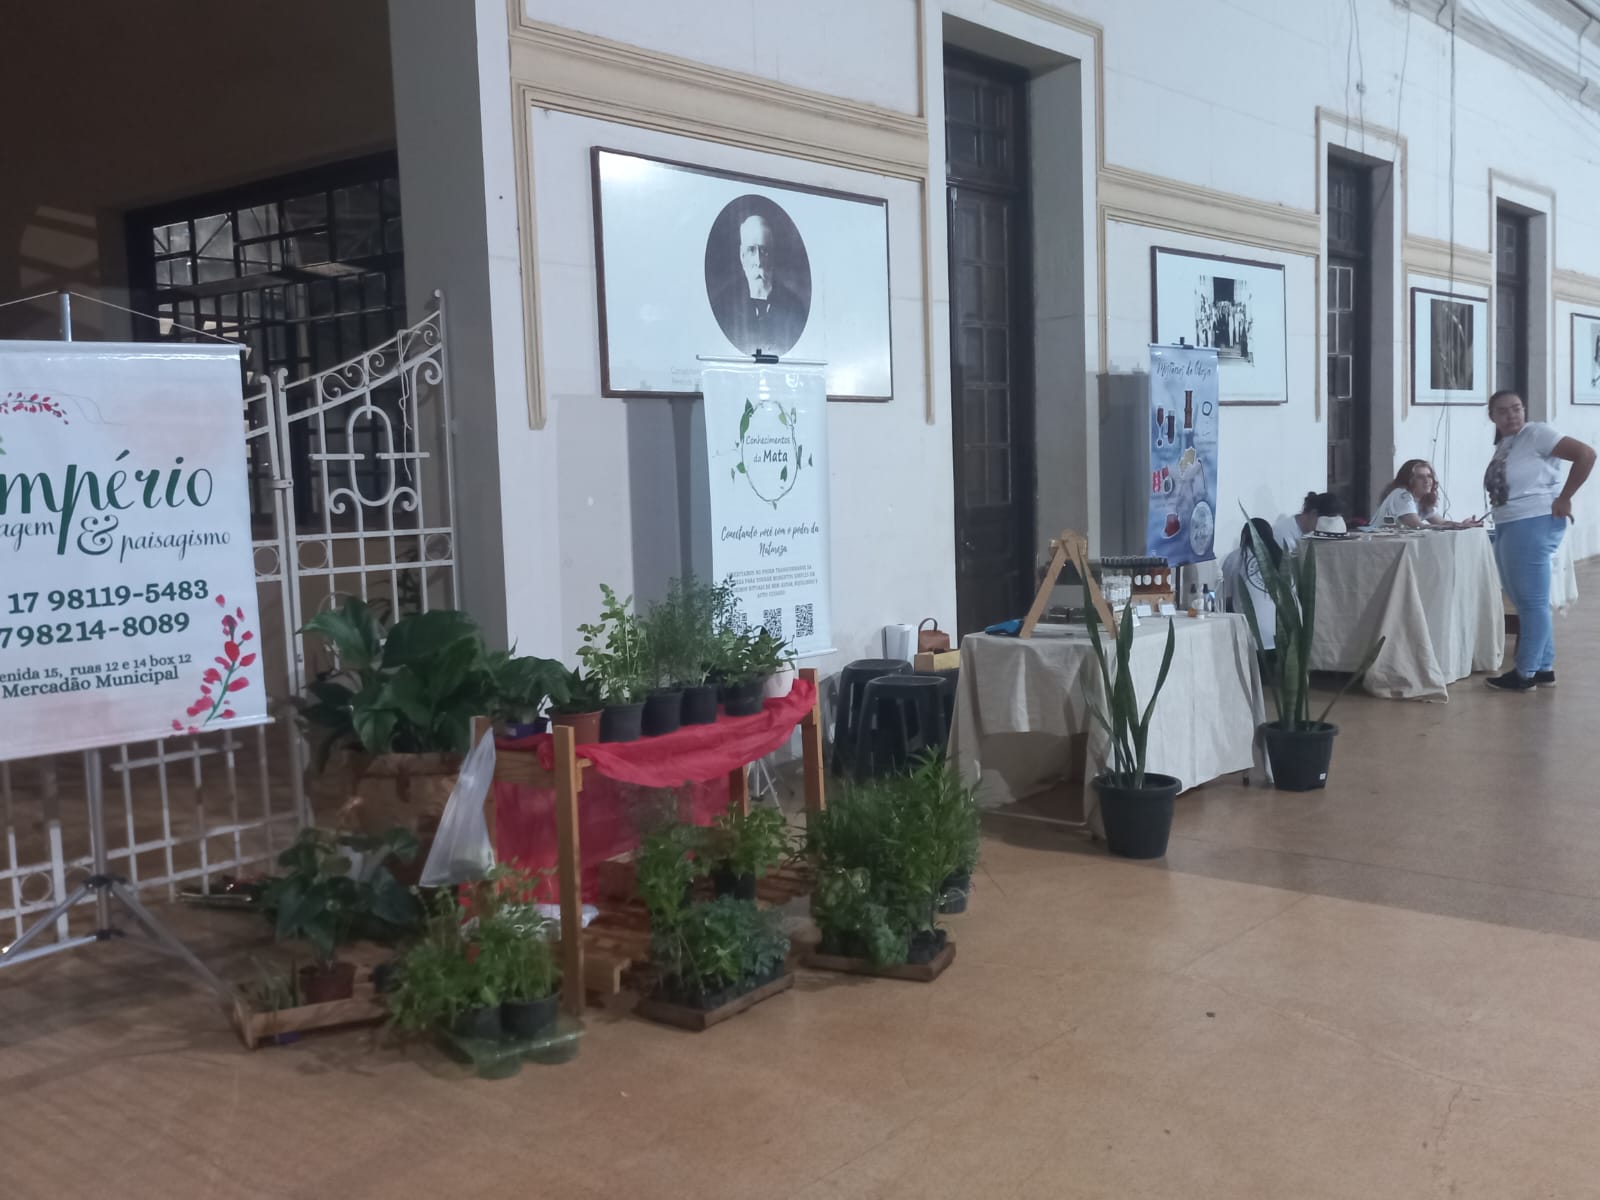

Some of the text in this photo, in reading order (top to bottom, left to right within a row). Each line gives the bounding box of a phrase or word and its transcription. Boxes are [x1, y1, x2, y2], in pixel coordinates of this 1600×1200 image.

[746, 435, 791, 445] Conhecimentos
[763, 449, 788, 463] Mata
[77, 514, 119, 555] &
[721, 525, 758, 541] Conectando
[119, 530, 231, 564] paisagismo
[759, 541, 788, 557] Natureza
[8, 579, 209, 614] 17 98119-5483
[44, 667, 63, 680] 15,
[70, 664, 102, 676] ruas
[105, 662, 119, 672] 12
[122, 661, 130, 670] e
[134, 659, 147, 669] 14
[149, 655, 175, 667] box
[178, 653, 192, 664] 12
[2, 666, 180, 699] Mercadão Municipal
